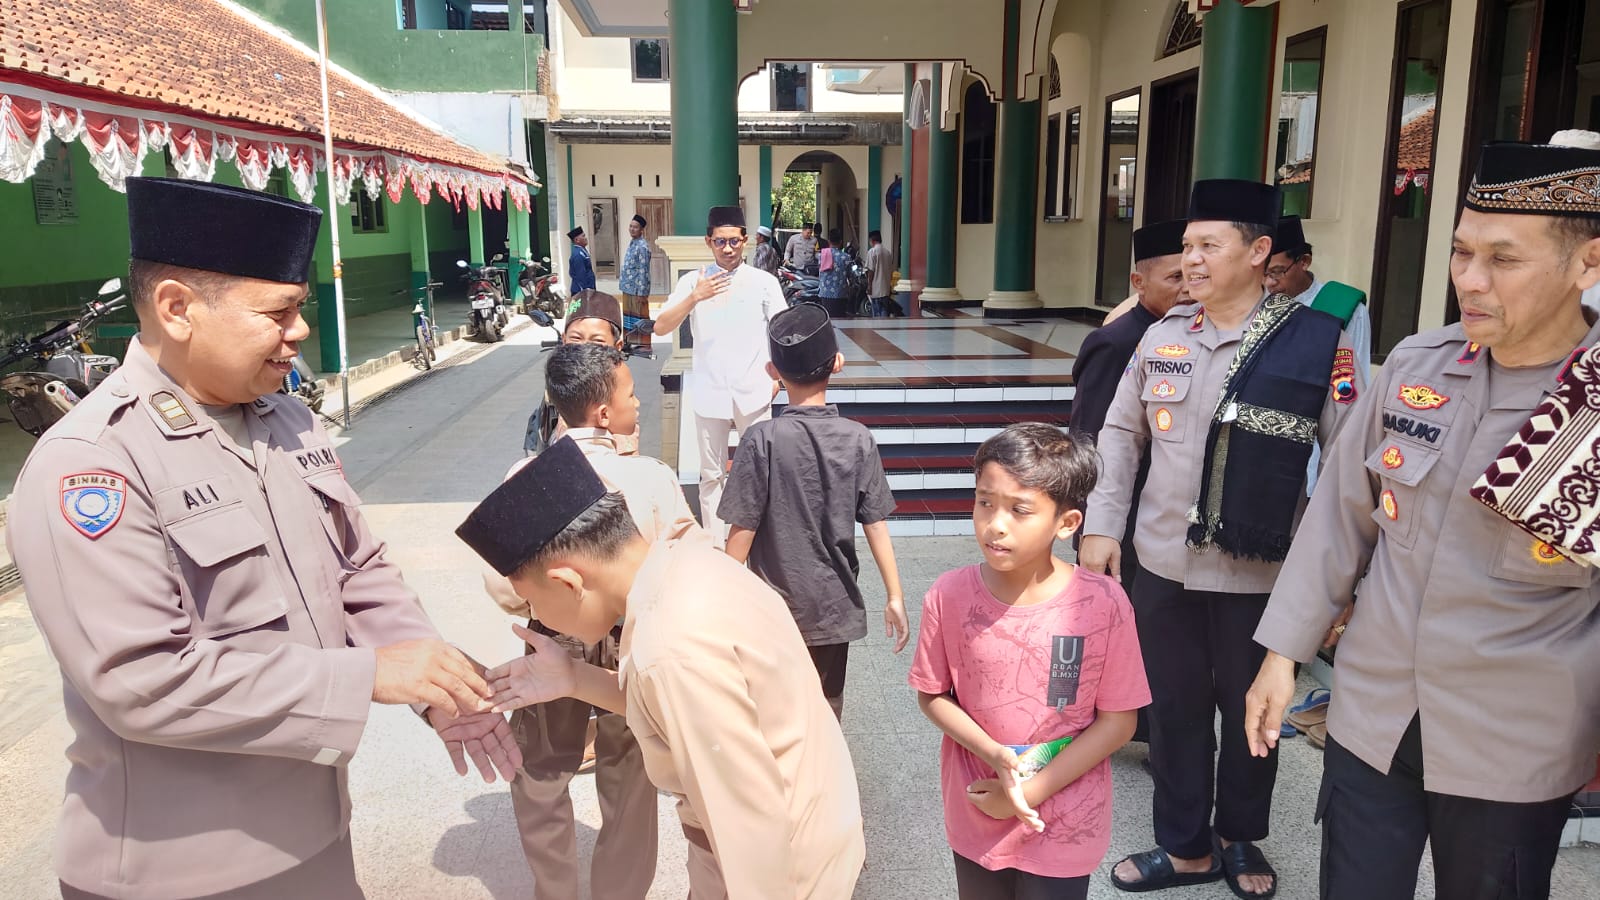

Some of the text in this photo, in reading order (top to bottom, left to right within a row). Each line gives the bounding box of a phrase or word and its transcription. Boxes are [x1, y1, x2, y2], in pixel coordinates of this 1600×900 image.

[1148, 361, 1193, 375] TRISNO
[296, 447, 336, 470] POLRI
[183, 484, 220, 511] ALI
[1059, 637, 1078, 664] U
